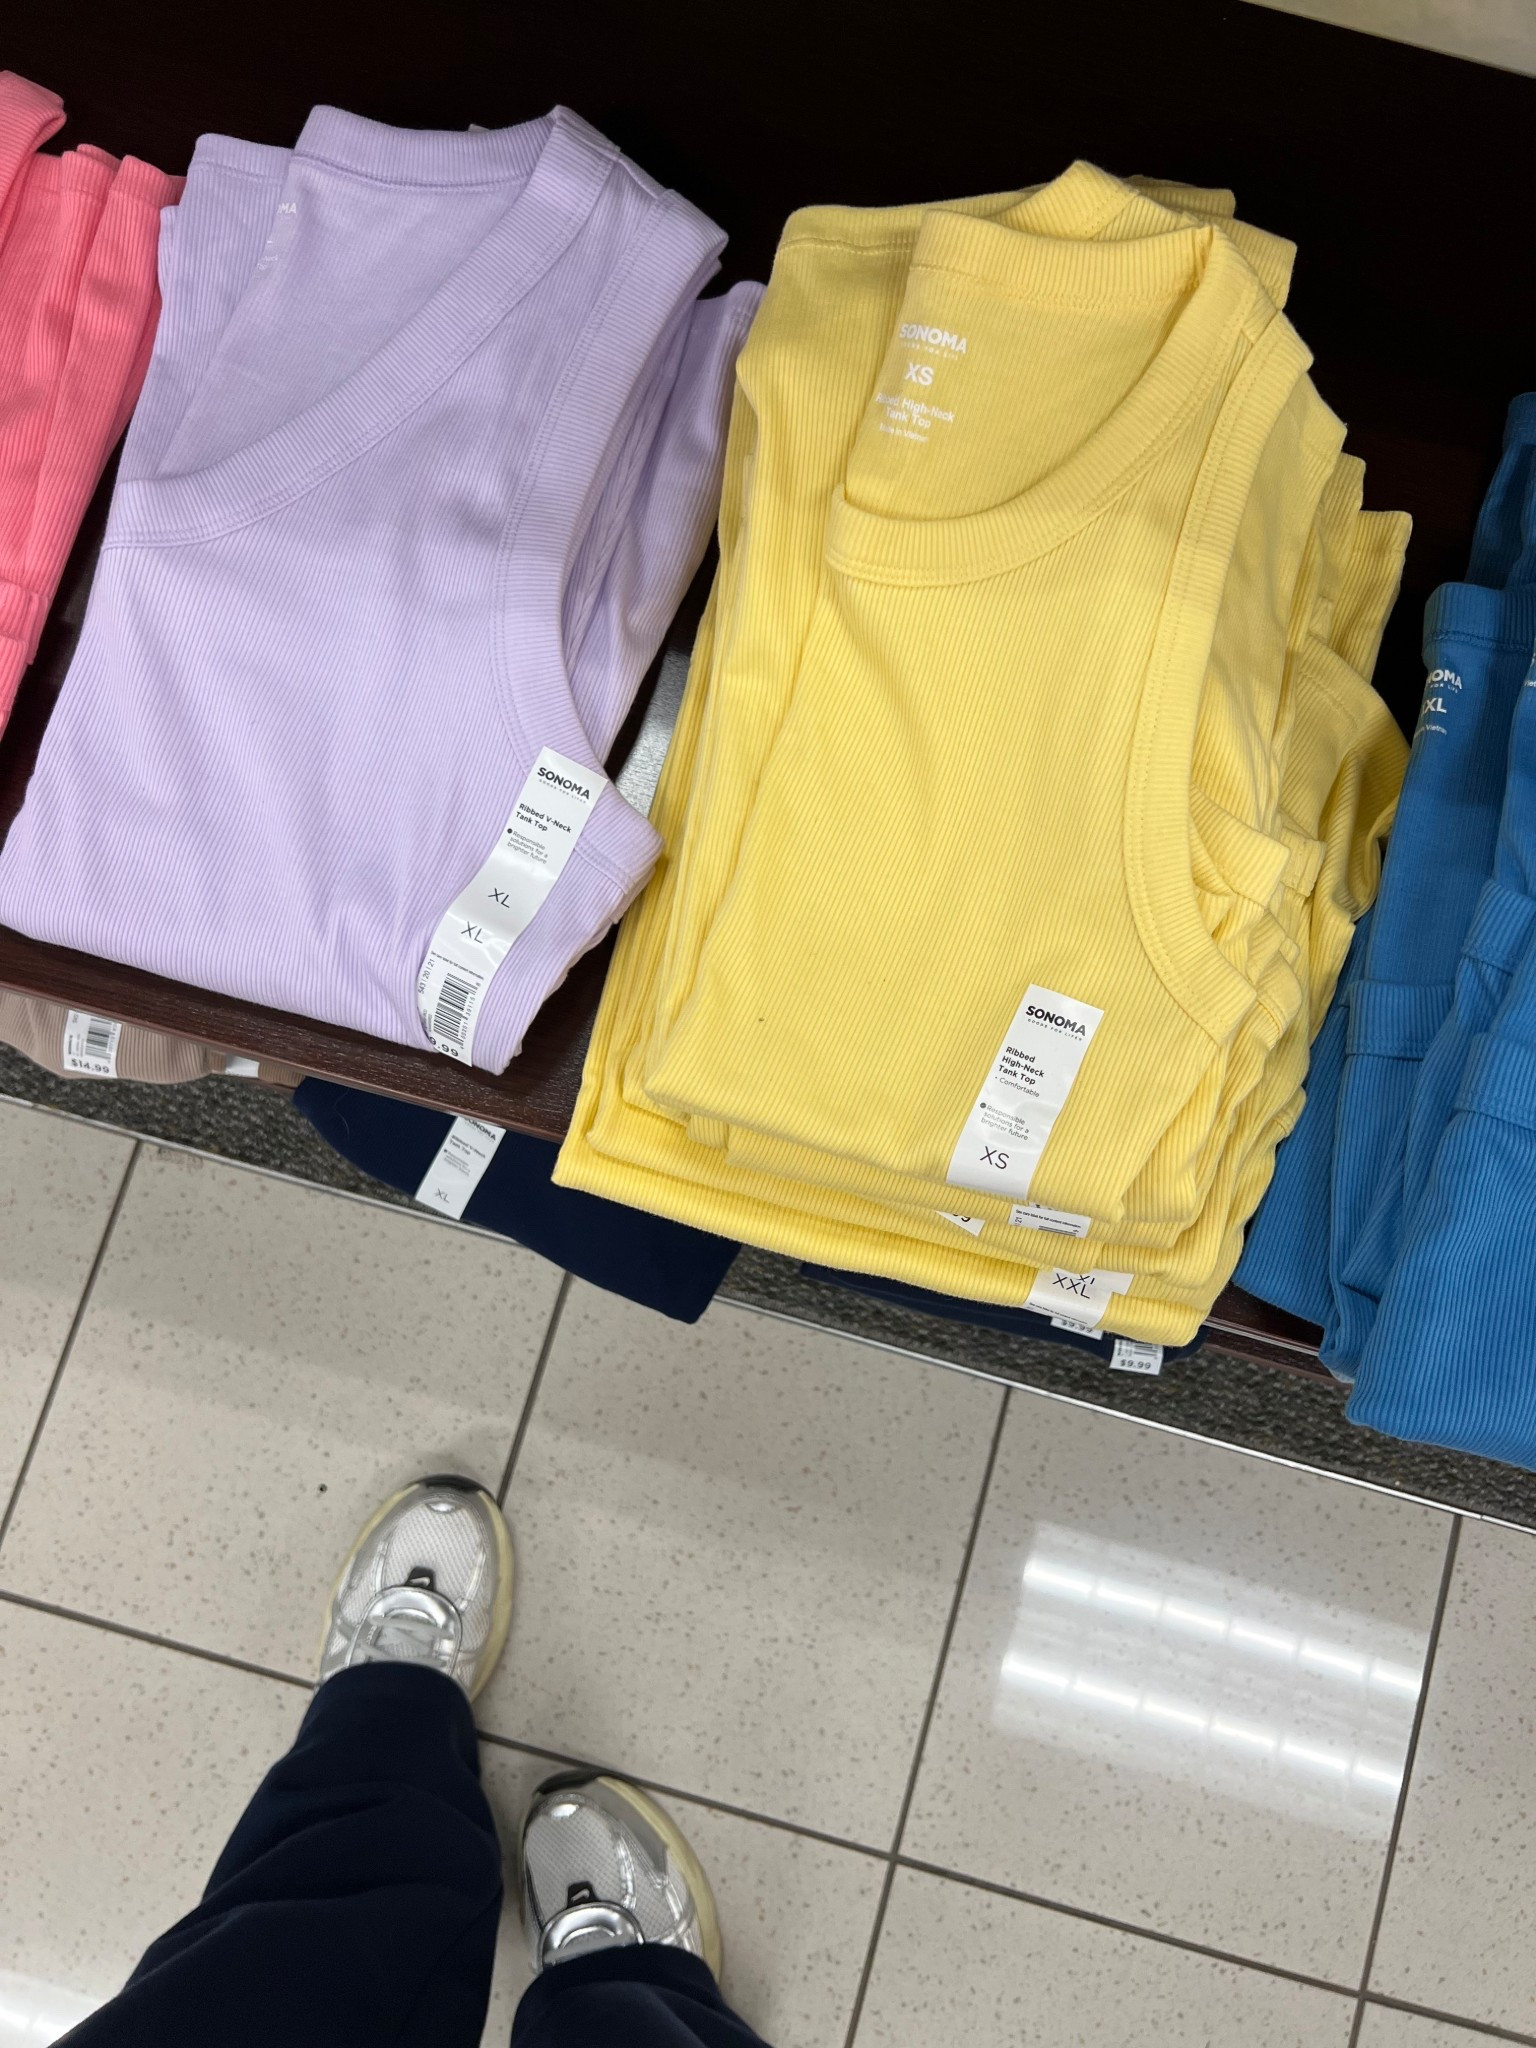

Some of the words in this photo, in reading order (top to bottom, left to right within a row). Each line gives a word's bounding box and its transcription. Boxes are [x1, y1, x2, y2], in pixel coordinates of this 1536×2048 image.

[277, 202, 297, 214] MA
[899, 323, 967, 355] SONOMA
[904, 362, 934, 387] XS
[886, 407, 908, 422] Tank
[911, 414, 932, 430] Top
[537, 767, 590, 799] SONOMA
[516, 811, 533, 825] Tank
[534, 820, 548, 832] Top
[519, 803, 546, 820] Ribbed
[546, 815, 572, 834] V-Neck
[509, 837, 534, 852] solutions
[535, 848, 544, 857] for
[513, 830, 546, 851] Responsible
[507, 841, 530, 857] brighter
[530, 852, 548, 865] future
[487, 888, 511, 909] XL
[460, 921, 483, 944] XL
[422, 970, 431, 980] 20
[1026, 1005, 1086, 1037] SONOMA
[1027, 1018, 1049, 1029] GOODS
[1049, 1026, 1062, 1034] FOR
[1005, 1046, 1036, 1063] Ribbed
[998, 1064, 1018, 1078] Tank
[1019, 1072, 1036, 1086] Top
[1001, 1055, 1045, 1078] High-Neck
[999, 1077, 1040, 1099] Comfortable
[983, 1112, 1013, 1128] solutions
[1013, 1123, 1024, 1132] for
[986, 1104, 1026, 1126] Responsible
[464, 1118, 496, 1141] ONOMA
[980, 1117, 1007, 1132] brighter
[1008, 1128, 1028, 1141] future
[979, 1145, 1010, 1170] XS
[434, 1187, 450, 1204] XL
[1052, 1272, 1091, 1300] XXL
[1120, 1359, 1152, 1370] $9.99
